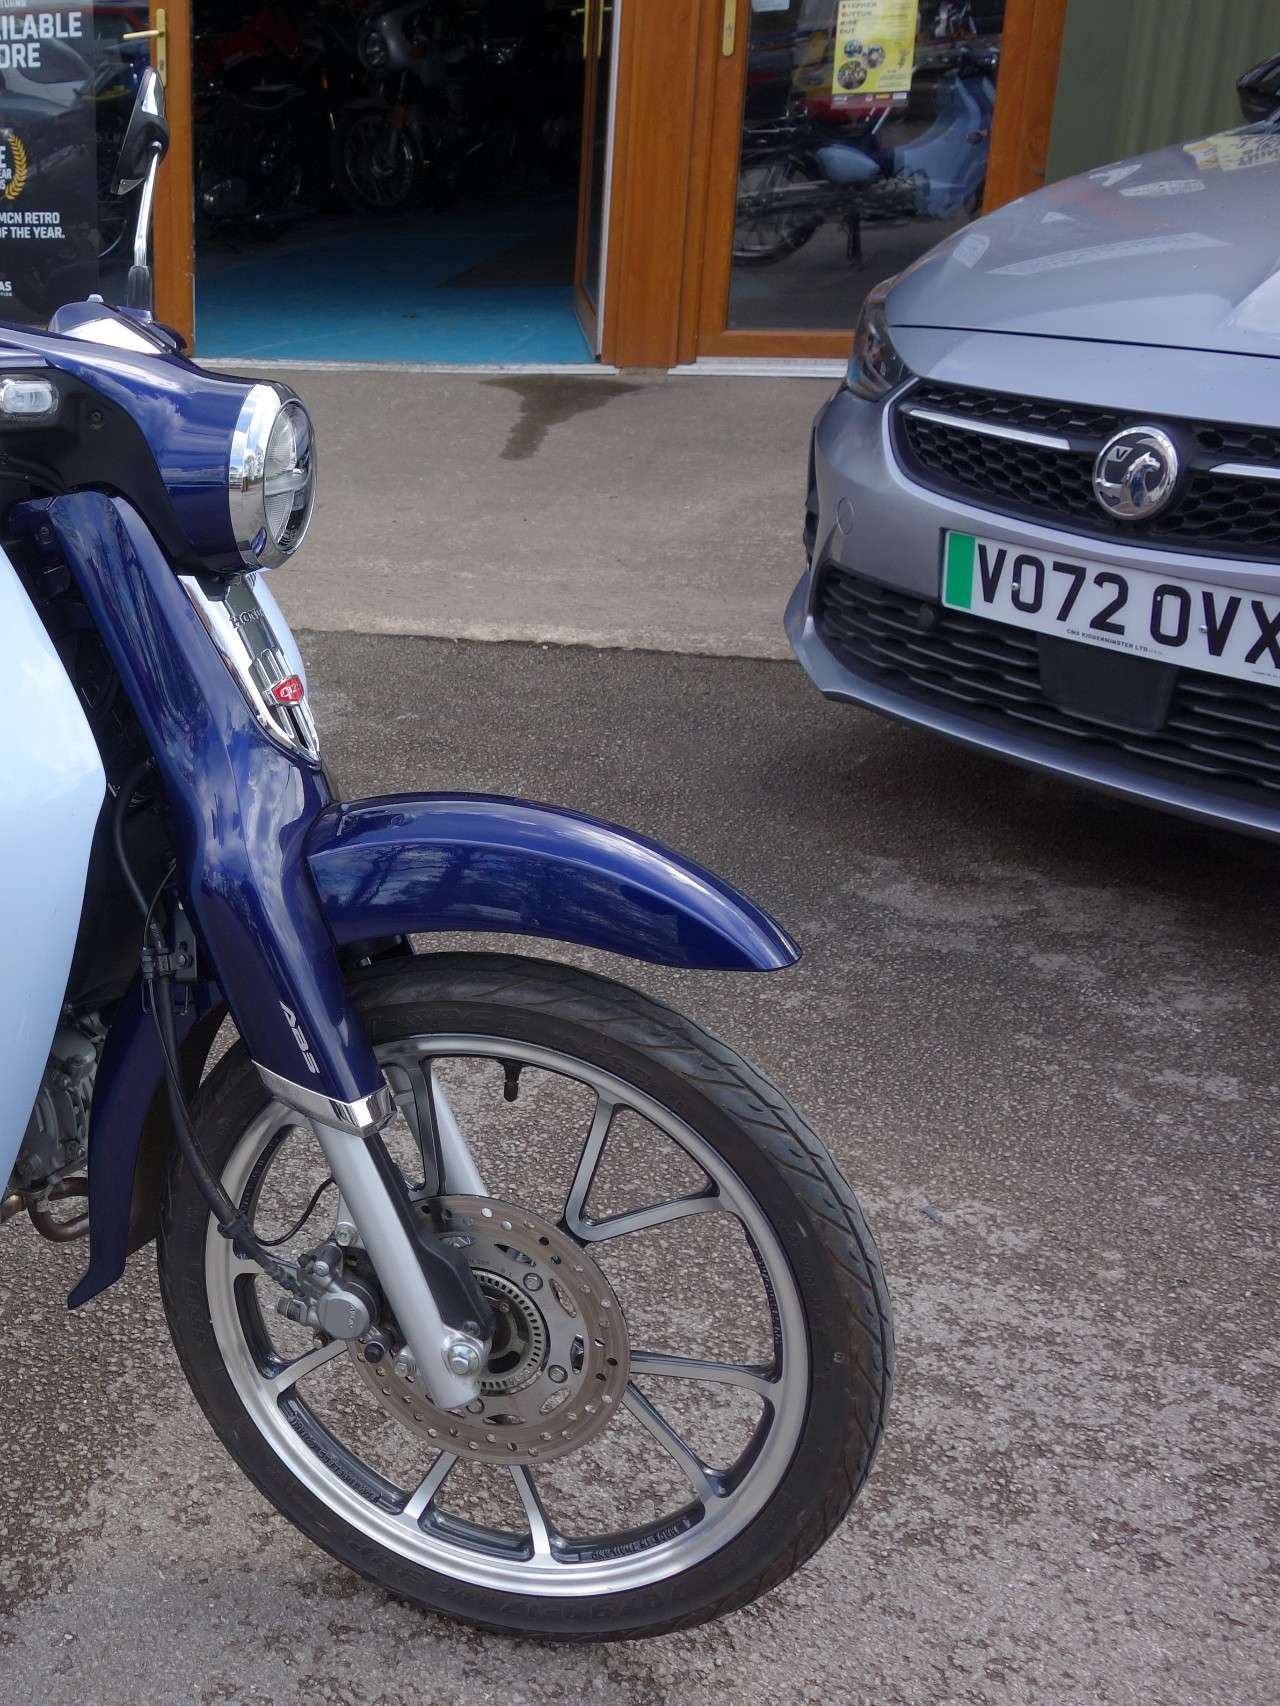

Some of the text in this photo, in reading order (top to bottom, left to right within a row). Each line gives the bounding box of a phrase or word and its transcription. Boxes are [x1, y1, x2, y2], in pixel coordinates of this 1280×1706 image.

[24, 212, 60, 224] RETRO
[10, 226, 31, 238] THE
[32, 226, 66, 238] YEAR.
[1135, 643, 1148, 652] LTD
[279, 1000, 321, 1074] ABS
